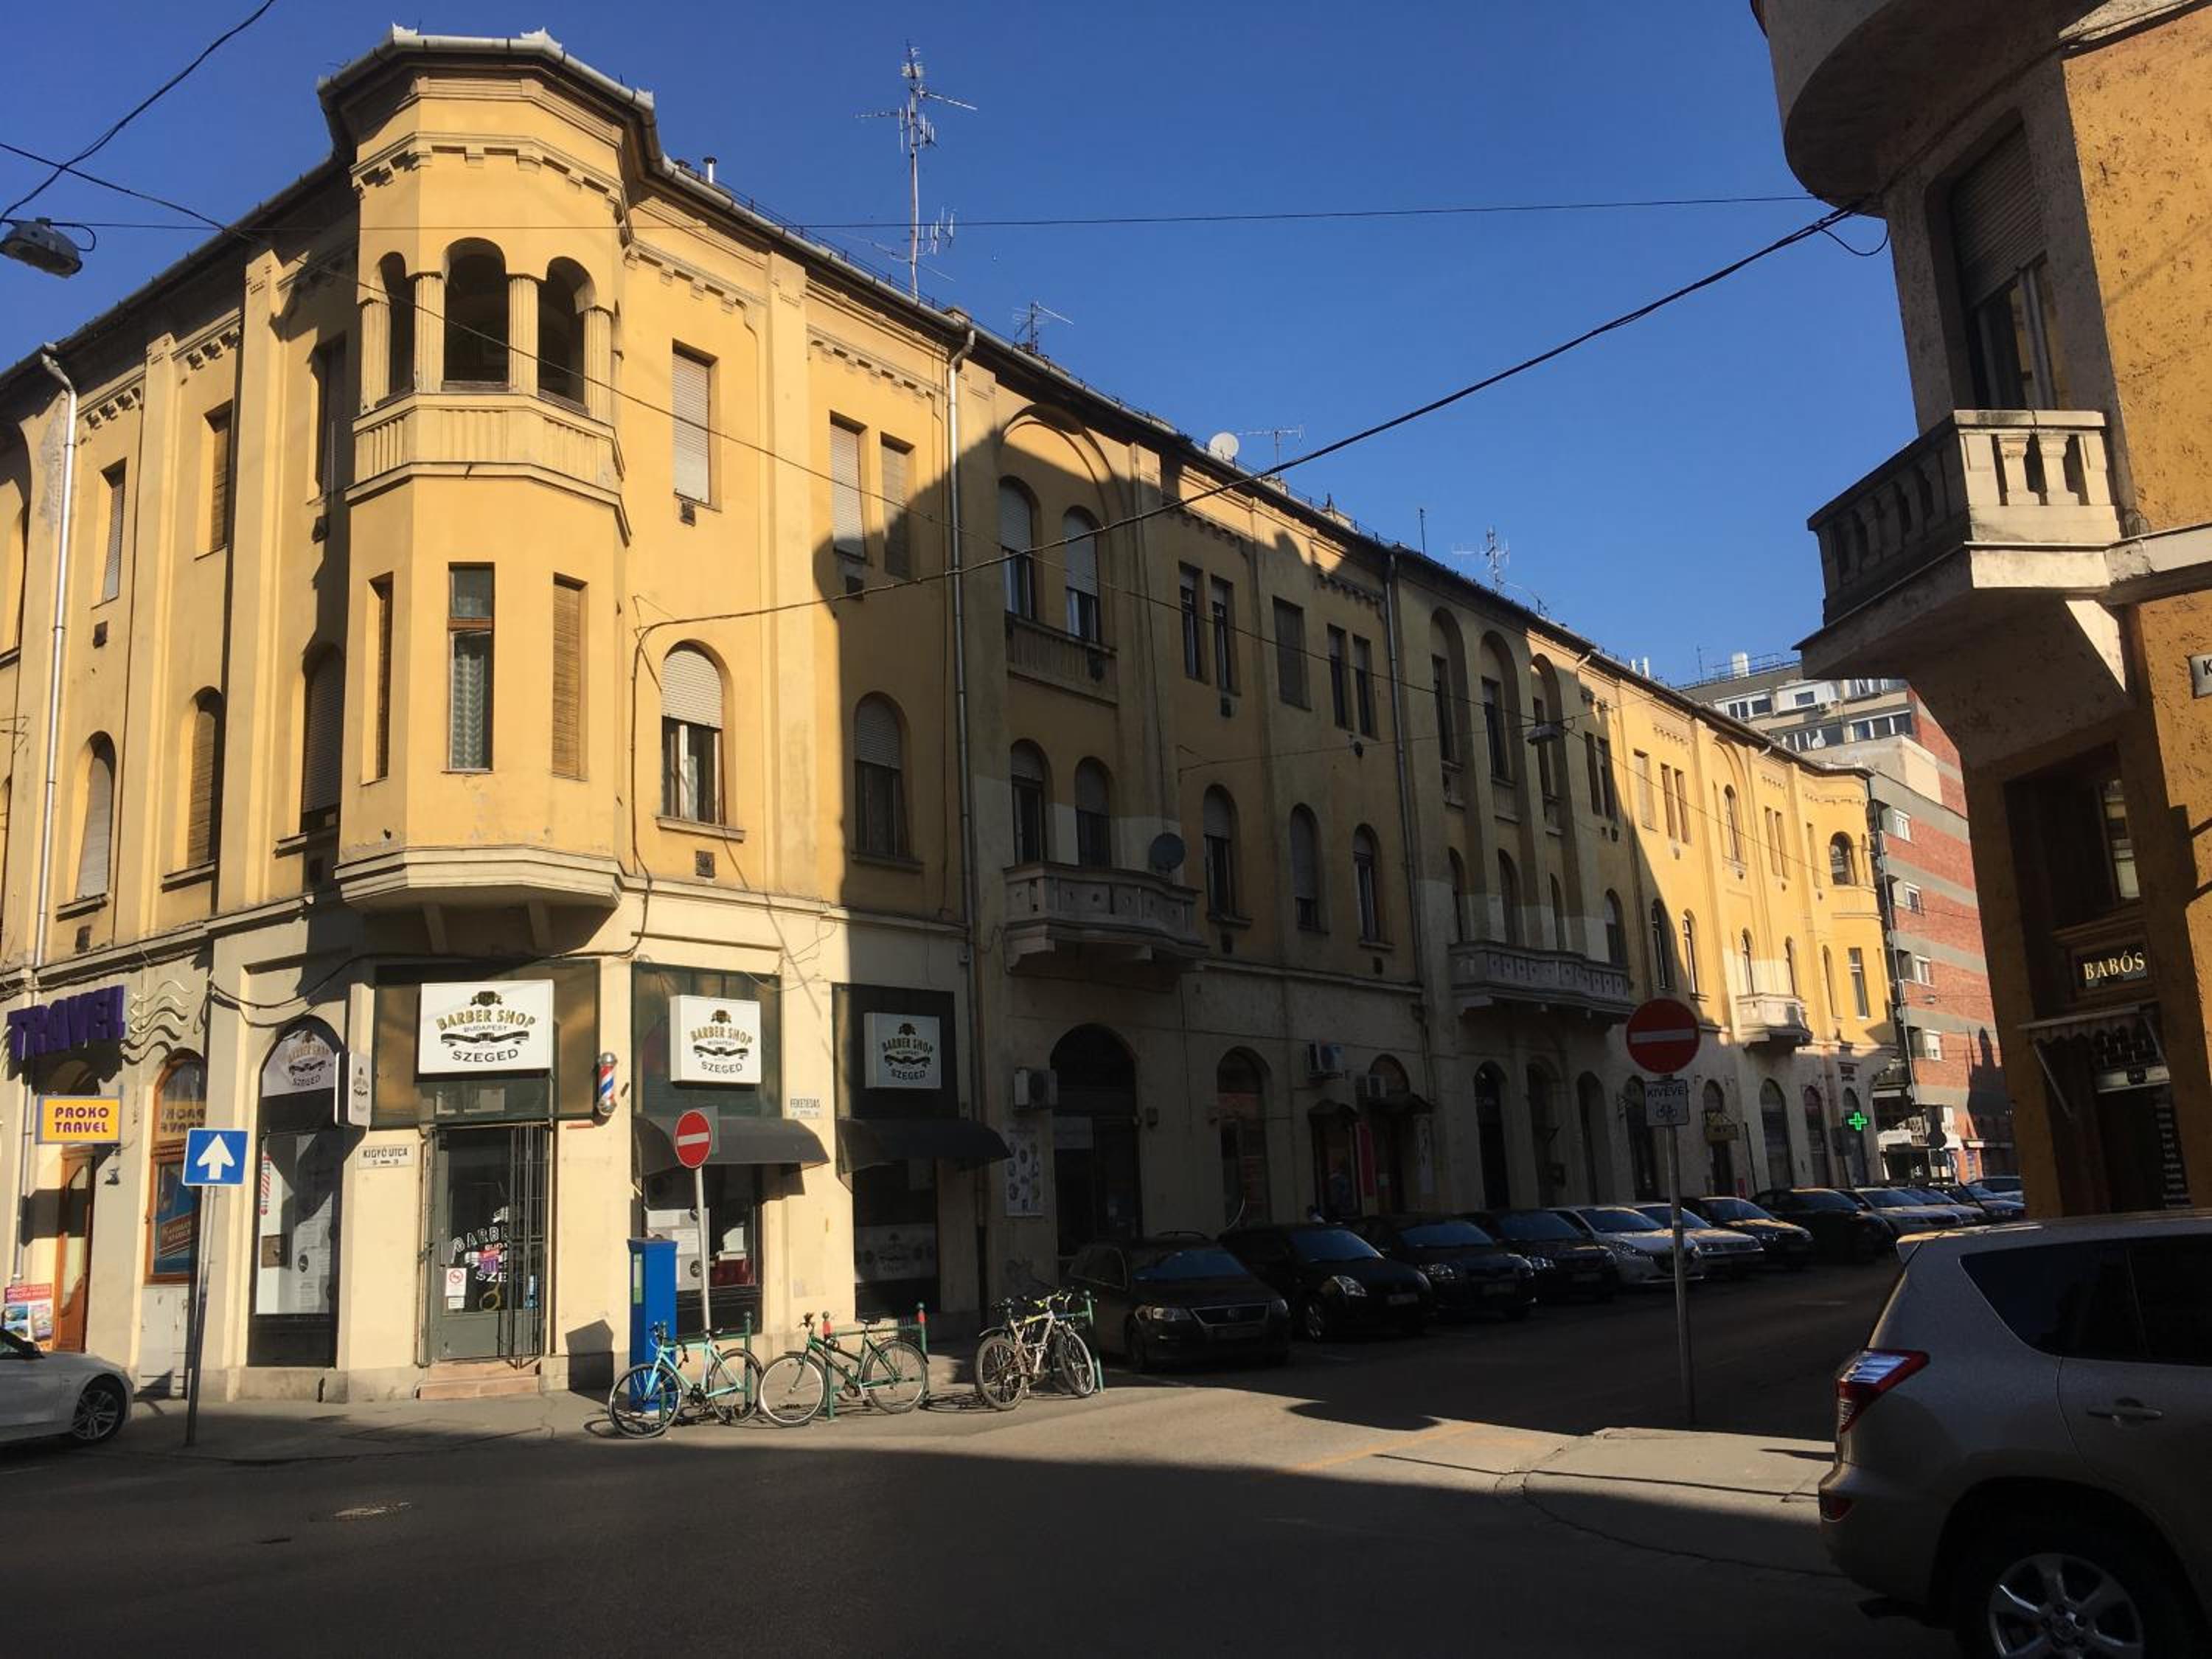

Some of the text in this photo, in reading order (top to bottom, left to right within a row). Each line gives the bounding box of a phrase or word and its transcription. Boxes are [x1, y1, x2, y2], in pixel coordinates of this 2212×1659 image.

[2083, 950, 2145, 980] BABÓS
[437, 1009, 536, 1032] BARBER SHOP
[464, 1025, 507, 1033] BUDAPEST
[690, 1026, 752, 1045] BARBER SHOP
[882, 1038, 933, 1055] BARBER SHOP
[452, 1048, 518, 1062] SZEGED
[701, 1062, 742, 1074] SZEGED
[891, 1068, 925, 1080] SZEGED
[1646, 1085, 1685, 1098] KIVÉVE
[55, 1107, 108, 1119] PROKO
[55, 1121, 108, 1133] TRAVEL
[389, 1147, 408, 1157] UTCA
